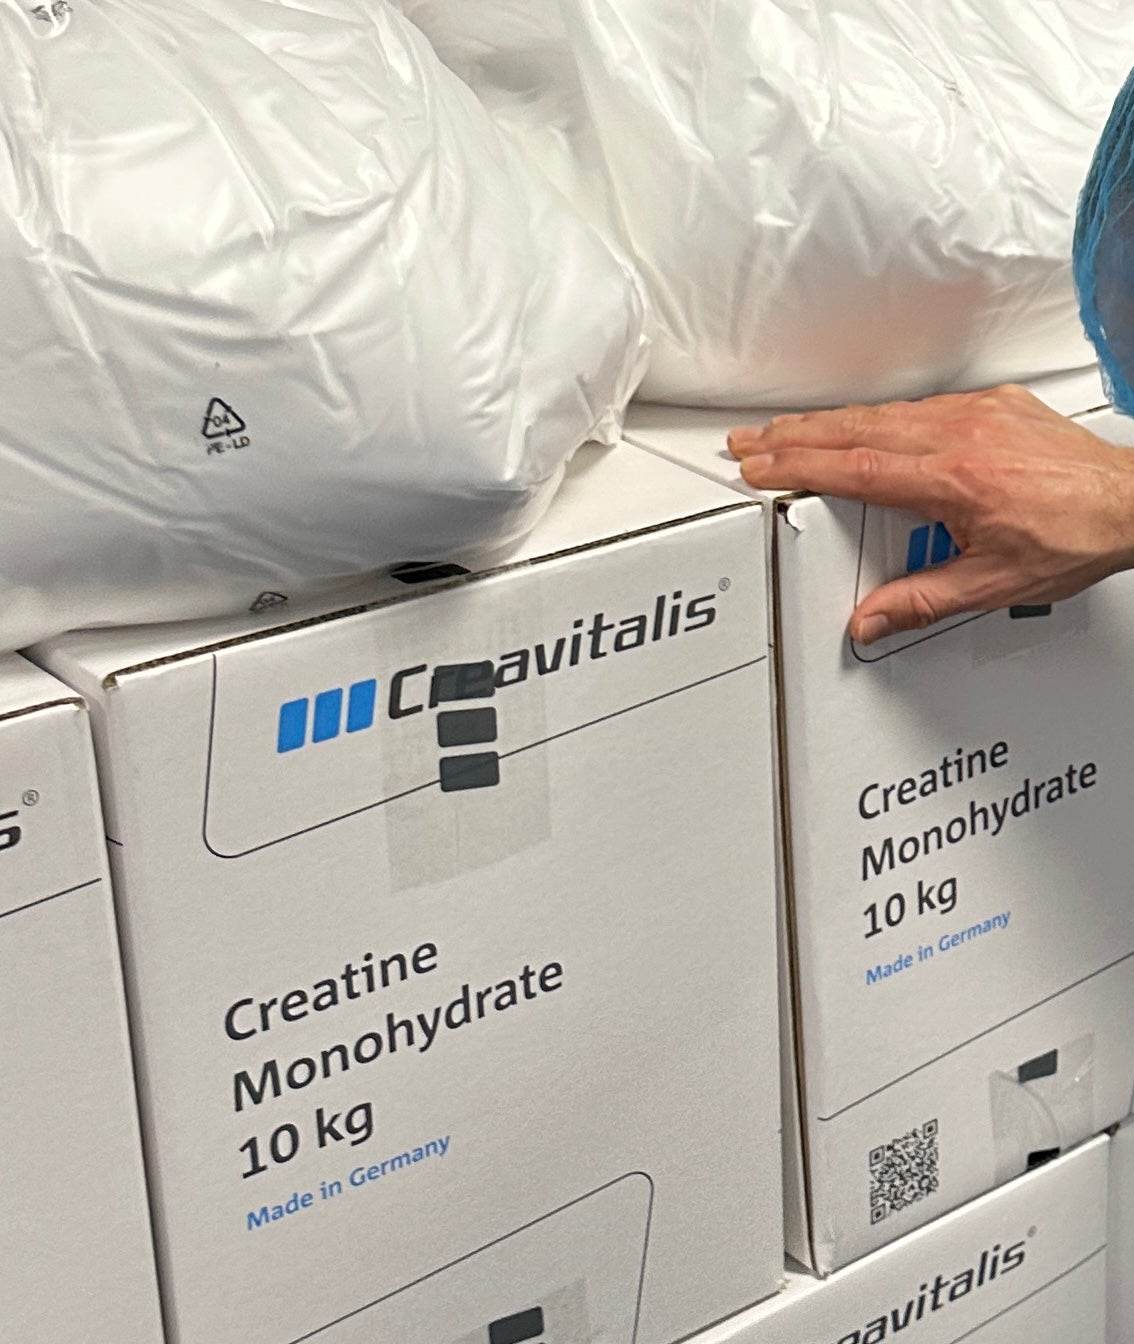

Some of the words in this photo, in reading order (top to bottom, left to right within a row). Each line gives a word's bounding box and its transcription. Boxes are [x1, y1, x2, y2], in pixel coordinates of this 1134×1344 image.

[858, 740, 1009, 820] Creatine
[861, 761, 1098, 881] Monohydrate
[863, 892, 906, 939] 10
[917, 877, 958, 915] kg
[866, 954, 913, 986] Made
[917, 944, 935, 962] in
[938, 910, 1012, 953] Germany
[224, 942, 439, 1041] Creatine
[233, 961, 564, 1113] Monohydrate
[238, 1123, 300, 1180] 10
[315, 1101, 374, 1149] kg
[246, 1192, 313, 1231] Made
[320, 1178, 343, 1201] in
[349, 1135, 451, 1188] Germany
